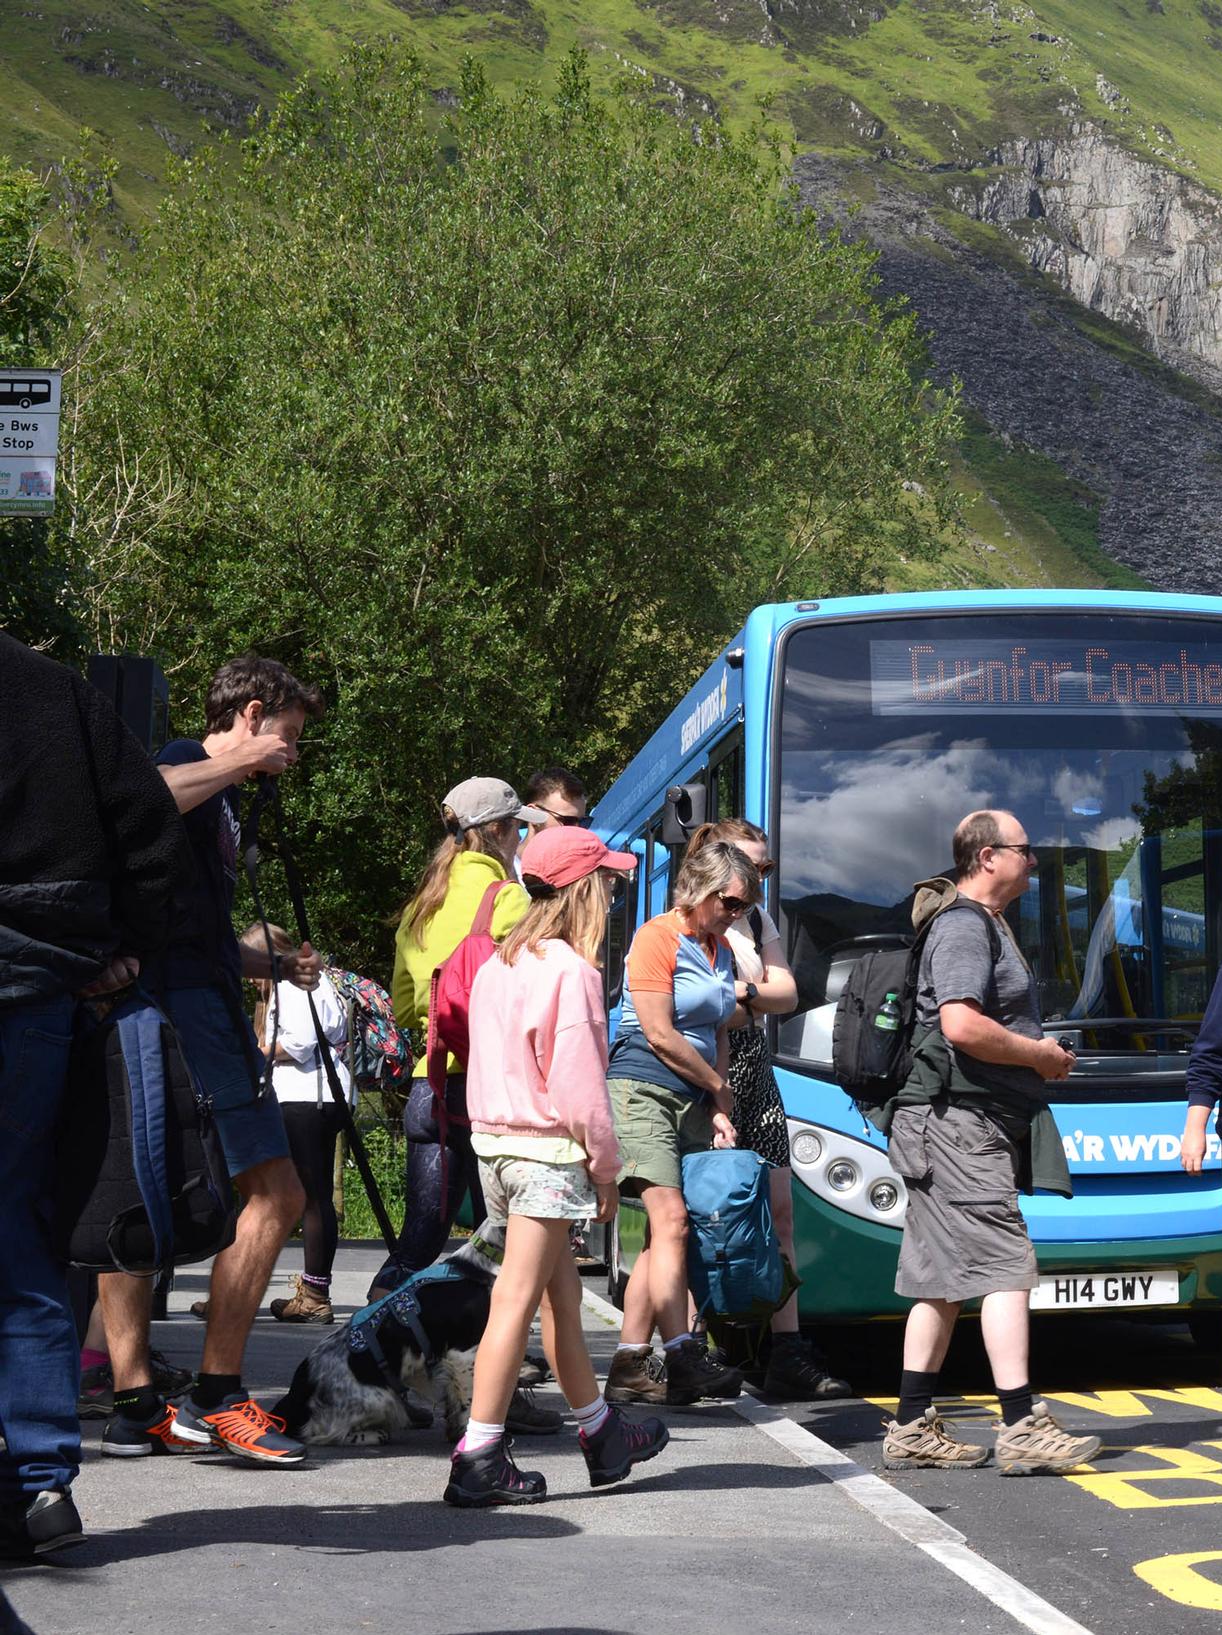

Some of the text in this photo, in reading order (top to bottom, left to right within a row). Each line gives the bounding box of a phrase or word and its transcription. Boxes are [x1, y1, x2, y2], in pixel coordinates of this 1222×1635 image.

[11, 420, 39, 432] Bws
[2, 437, 34, 451] Stop
[911, 644, 1072, 704] Gwynfor
[1109, 1133, 1222, 1162] WYDF
[1055, 1275, 1154, 1303] H14 GWY
